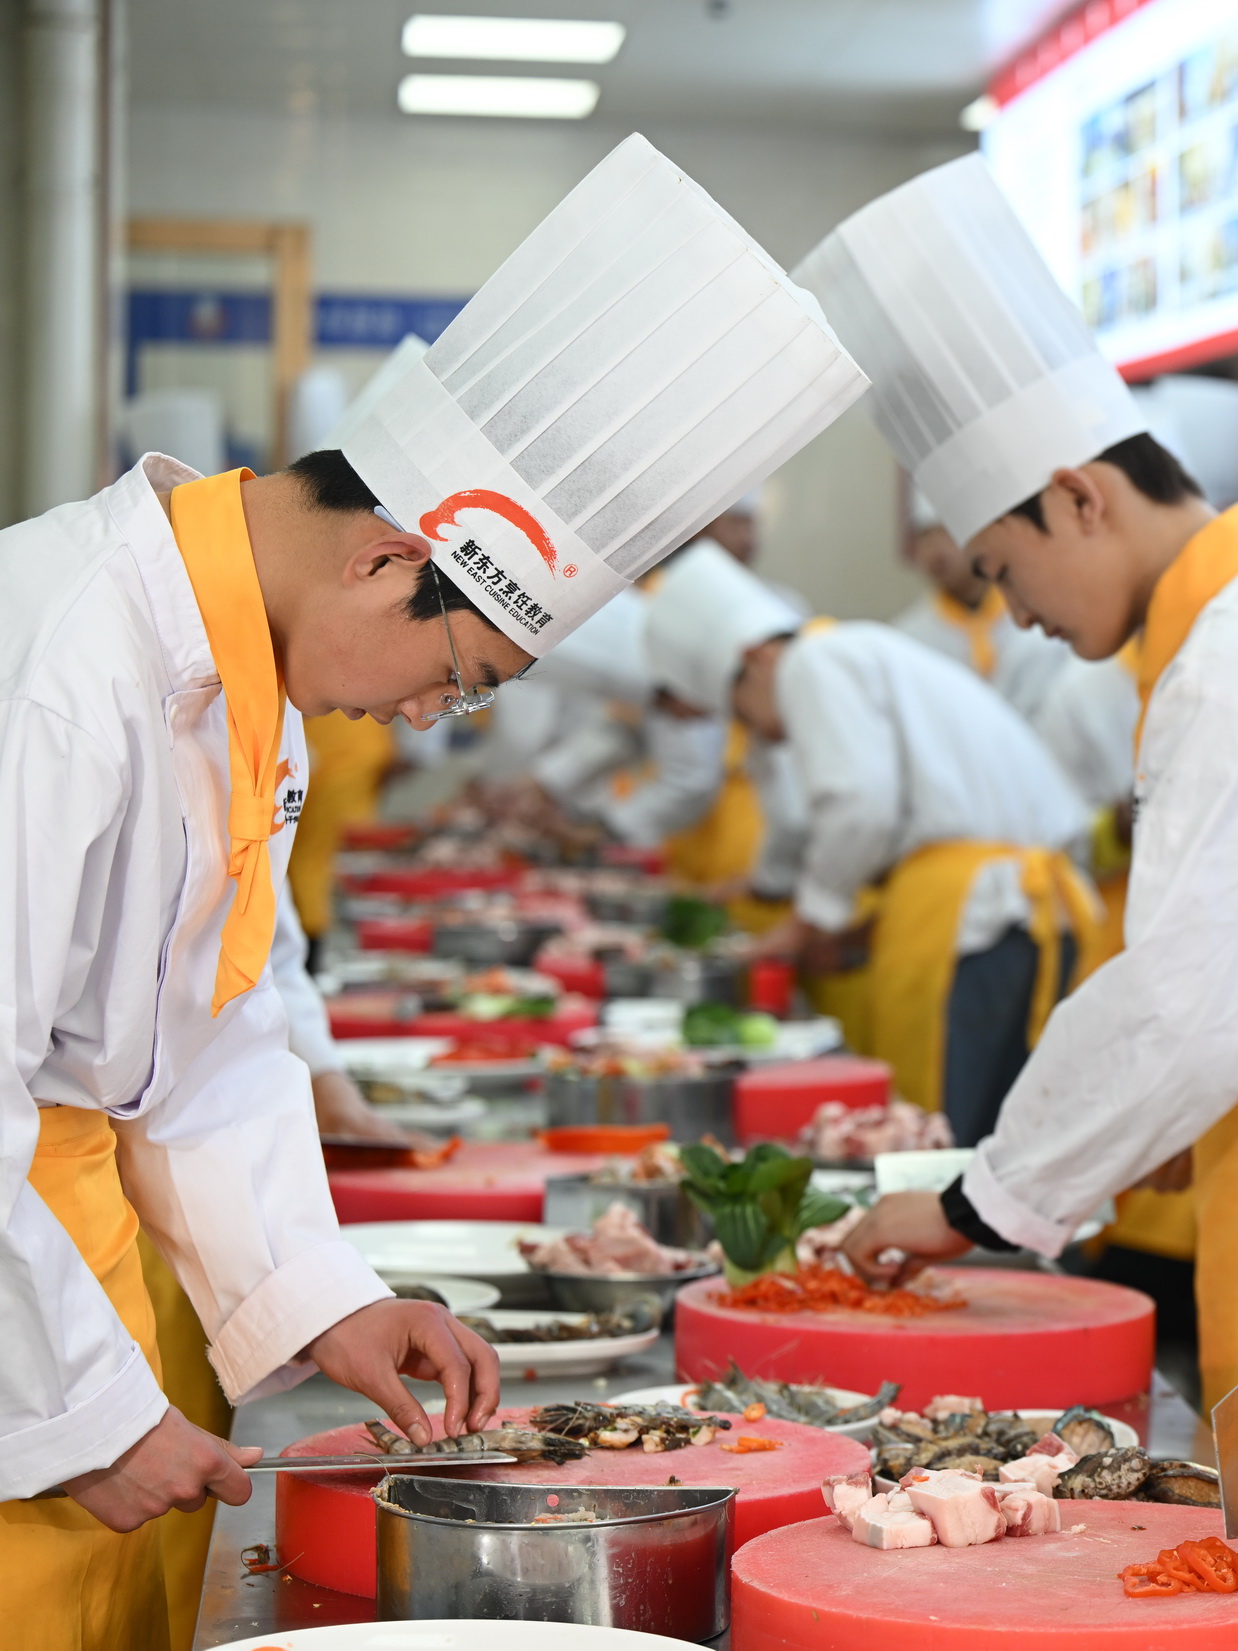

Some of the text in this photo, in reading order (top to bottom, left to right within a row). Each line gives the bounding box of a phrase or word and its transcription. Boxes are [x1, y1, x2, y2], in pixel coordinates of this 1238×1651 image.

[451, 550, 540, 636] NEW EAST CUISINE EDUCATION
[459, 539, 554, 628] 新东方烹饪教育
